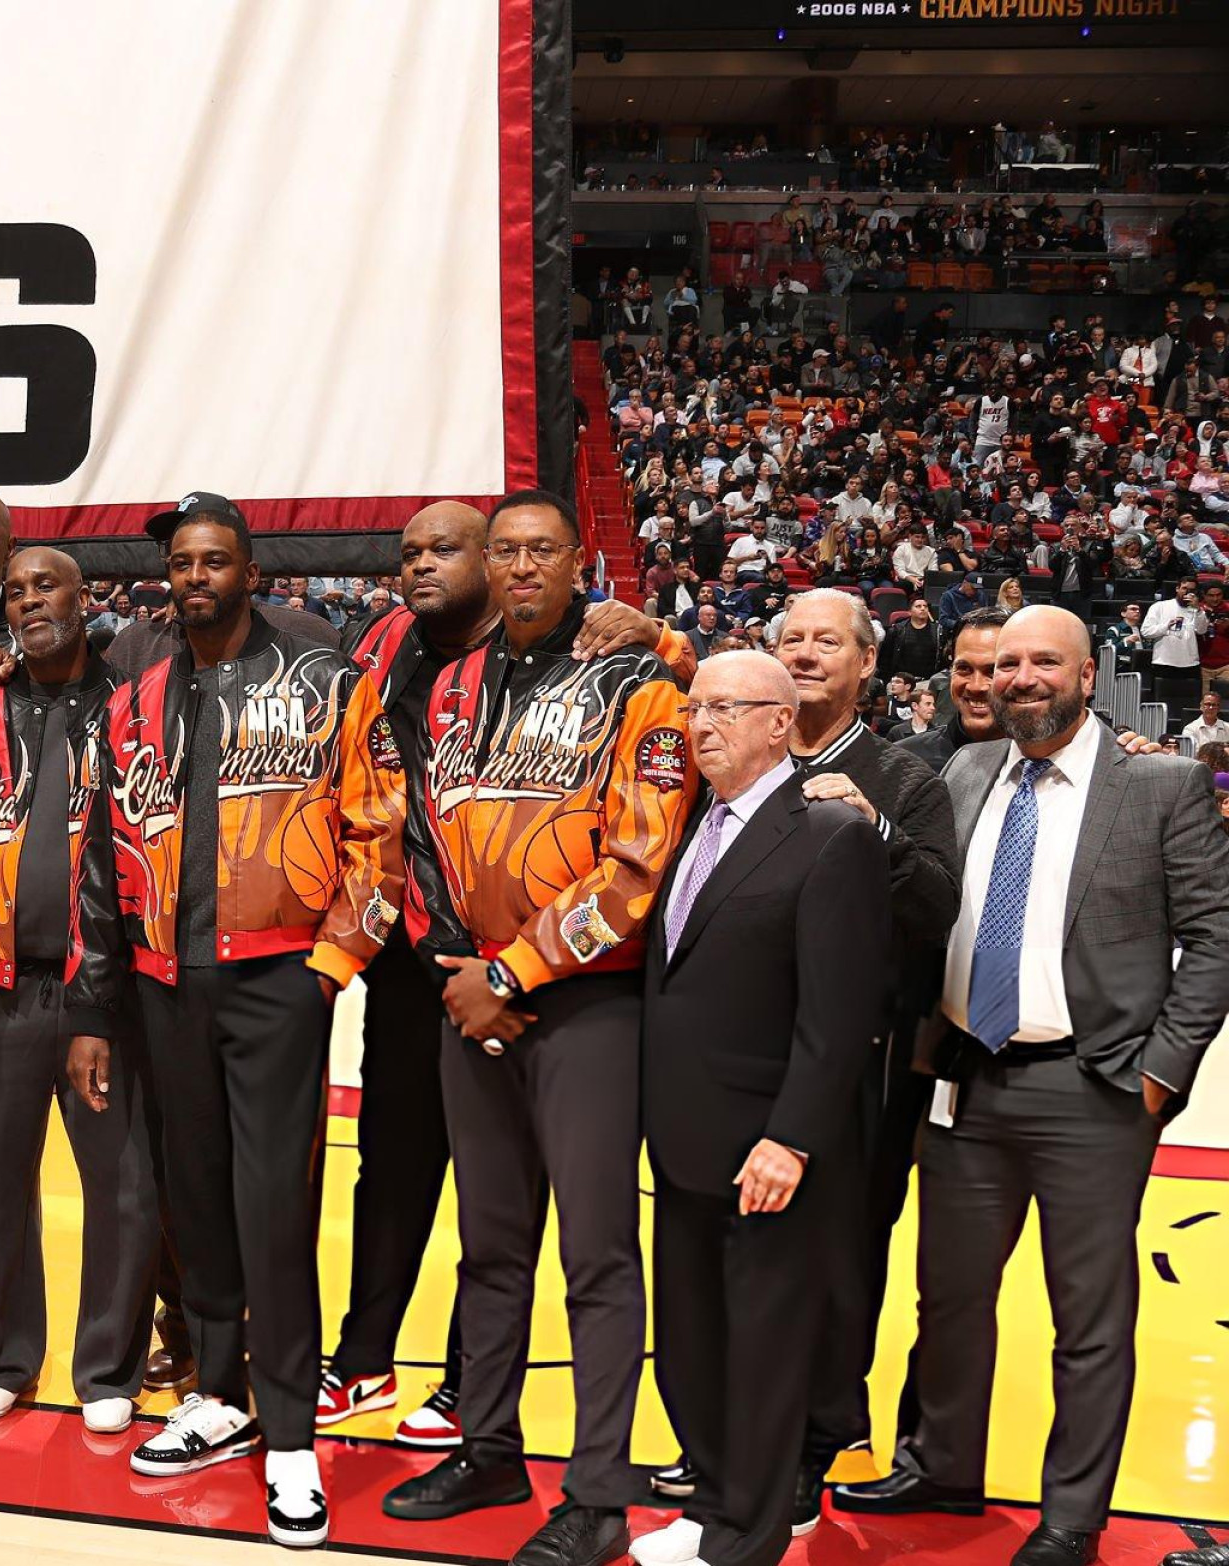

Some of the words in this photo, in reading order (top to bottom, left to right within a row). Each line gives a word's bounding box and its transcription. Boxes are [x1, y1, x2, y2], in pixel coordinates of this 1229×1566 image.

[810, 3, 857, 16] 2006
[862, 3, 897, 15] NBA
[920, 0, 1084, 19] CHAMPIONS
[1094, 0, 1181, 17] NIGHT
[246, 697, 309, 748] NBA
[521, 701, 585, 757] NBA
[652, 755, 681, 767] 2006
